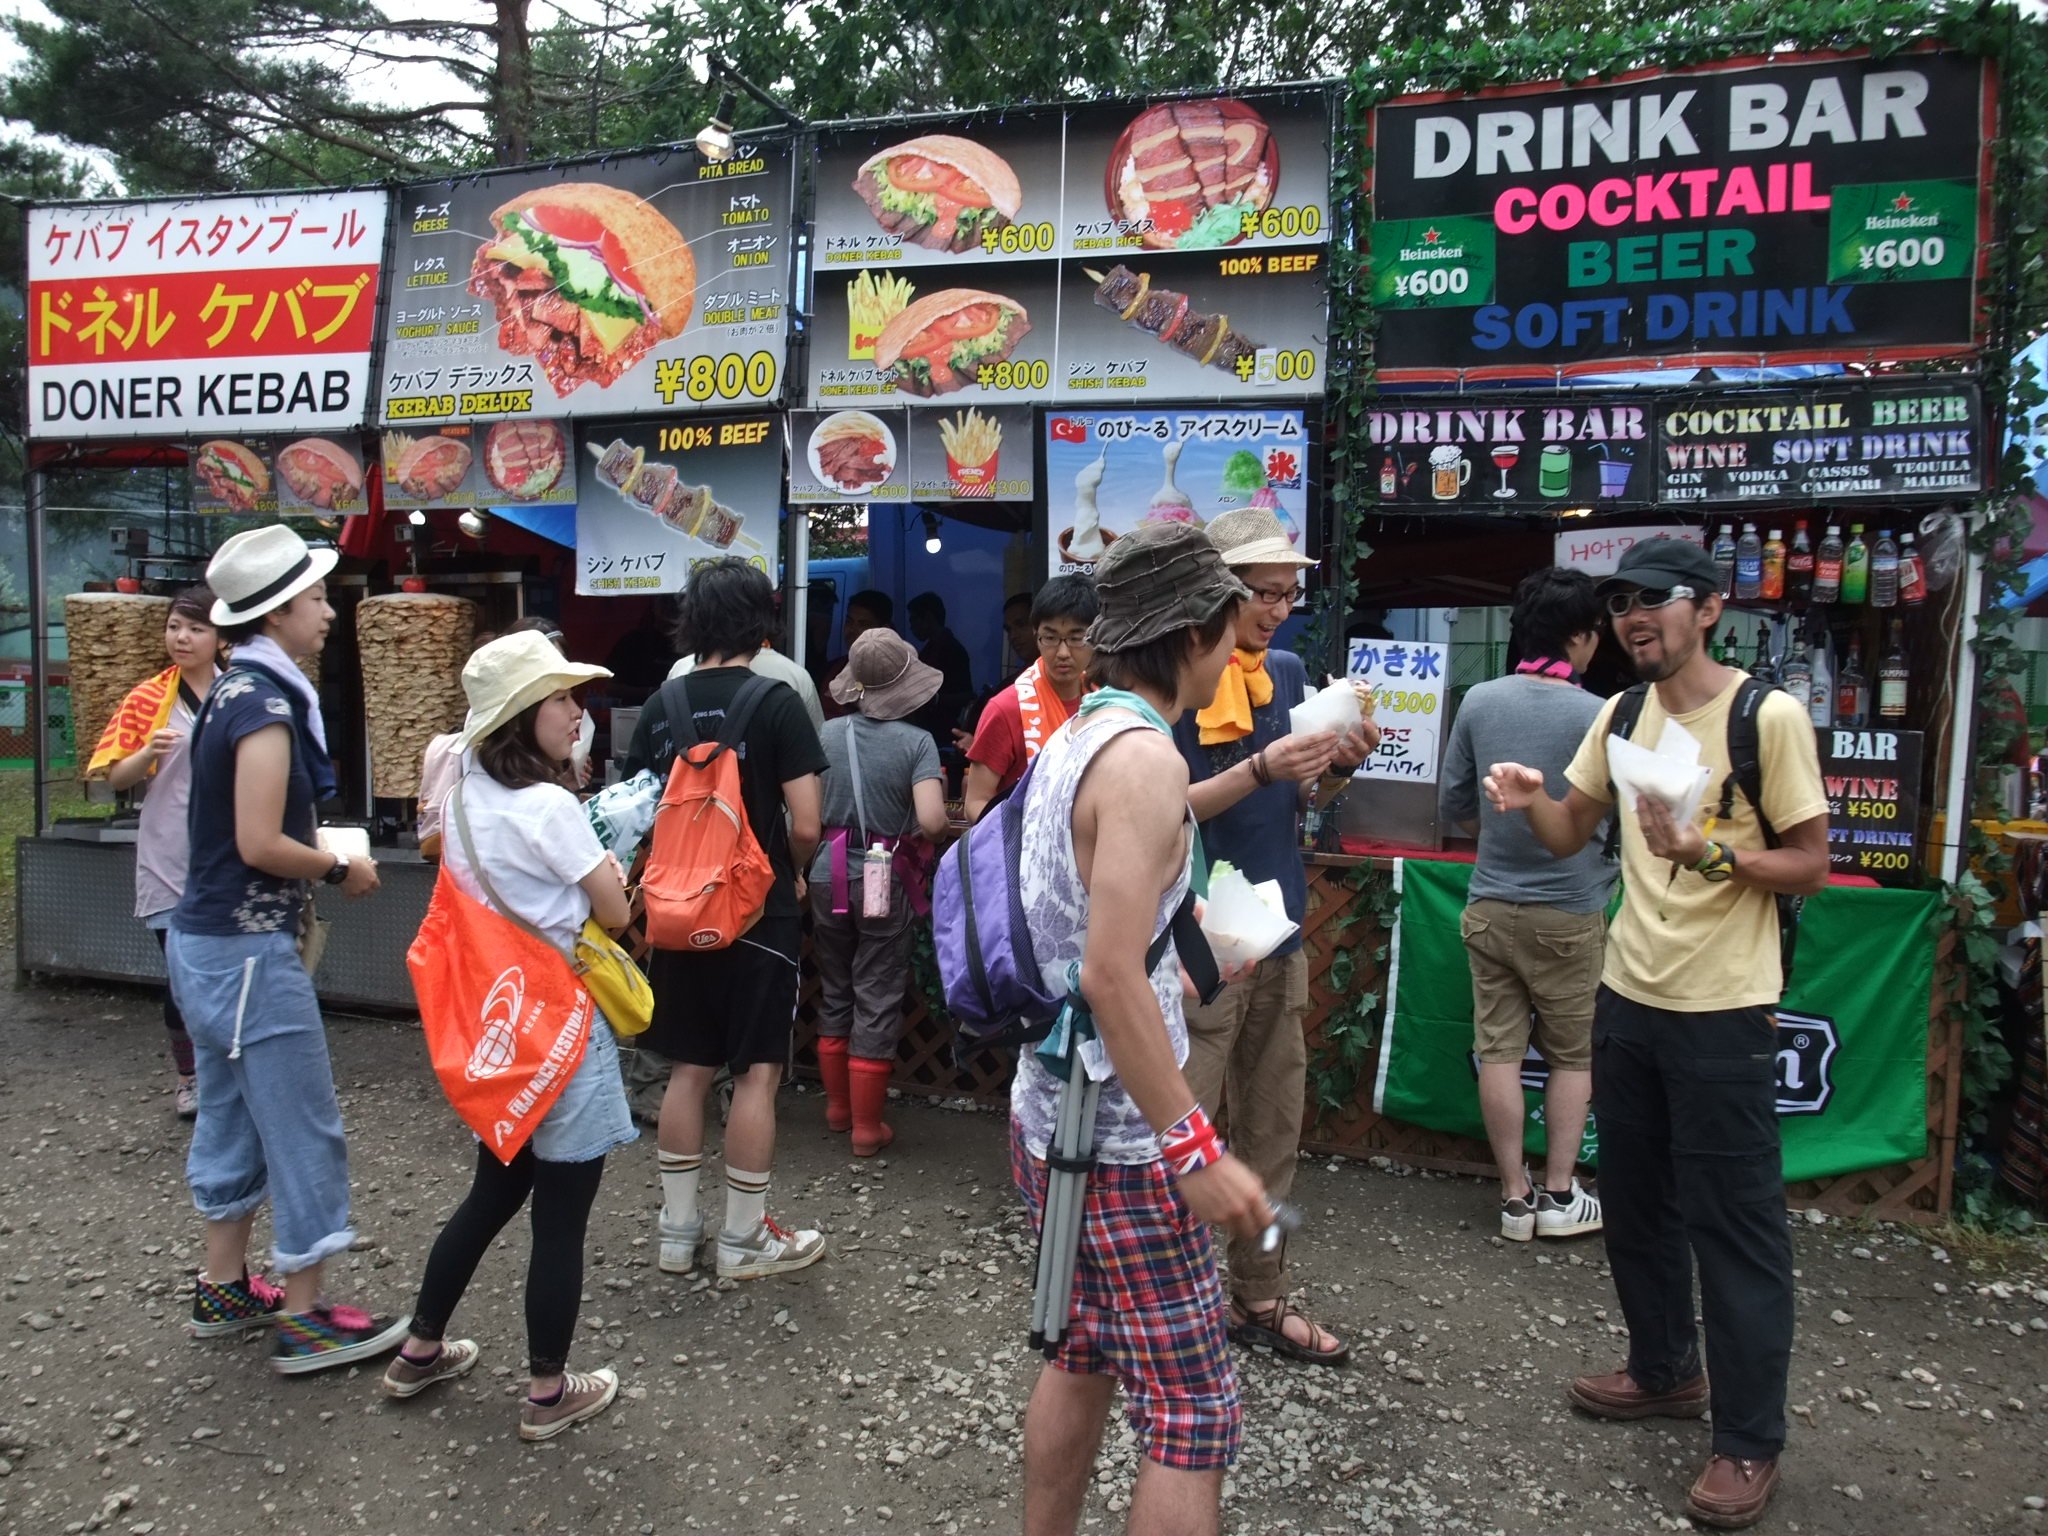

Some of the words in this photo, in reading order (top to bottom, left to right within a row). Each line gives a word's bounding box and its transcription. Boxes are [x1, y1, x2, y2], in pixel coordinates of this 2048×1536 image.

[1413, 90, 1700, 179] DRINK
[1729, 70, 1929, 153] BAR
[699, 164, 723, 179] PITA
[728, 159, 764, 175] BREAD
[730, 194, 760, 212] トマト
[1494, 163, 1831, 235] COCKTAIL
[415, 201, 451, 219] チーズ
[722, 208, 769, 225] TOMATO
[413, 218, 449, 233] CHEESE
[1074, 221, 1115, 236] ケバブ
[1118, 219, 1156, 233] ライス
[1241, 205, 1321, 240] ¥600
[1865, 214, 1938, 230] Heineken
[45, 218, 134, 265] ケバブ
[147, 208, 366, 259] イスタンブール
[727, 235, 778, 253] オニオン
[826, 236, 860, 250] ドネル
[866, 234, 904, 248] ケバブ
[981, 223, 1054, 255] ¥600
[1073, 238, 1112, 250] KEBAB
[1116, 236, 1144, 248] RICE
[733, 251, 769, 267] ONION
[825, 251, 864, 264] DONER
[865, 249, 903, 262] KEBAB
[1400, 247, 1463, 261] Heineken
[1568, 229, 1756, 289] BEER
[1859, 237, 1944, 269] ¥600
[414, 257, 445, 272] レタス
[1220, 257, 1262, 276] 100%
[1267, 254, 1319, 273] BEEF
[407, 272, 449, 287] LETTUCE
[1395, 267, 1469, 297] ¥600
[704, 293, 743, 309] ダブル
[748, 288, 781, 305] ミート
[40, 285, 176, 356] ドネル
[199, 272, 370, 349] ケバブ
[396, 307, 445, 323] ヨーグルト
[450, 304, 481, 318] ソース
[703, 309, 745, 325] DOUBLE
[751, 305, 780, 320] MEAT
[1471, 299, 1628, 351] SOFT
[1646, 286, 1855, 341] DRINK
[396, 325, 441, 338] YOGHURT
[446, 321, 479, 335] SAUCE
[820, 369, 845, 382] ドネル
[976, 360, 1049, 391] ¥800
[1069, 362, 1096, 376] シシ
[1105, 359, 1149, 375] ケバブ
[1235, 350, 1315, 383] ¥500
[389, 368, 442, 393] ケバブ
[448, 363, 533, 389] デラックス
[655, 350, 776, 405] ¥800
[1068, 378, 1103, 389] SHISH
[1107, 376, 1147, 387] KEBAB
[43, 376, 182, 421] DONER
[198, 370, 350, 417] KEBAB
[819, 385, 848, 397] DONER
[849, 384, 878, 396] KEBAB
[880, 383, 898, 395] SET
[386, 395, 455, 420] KEBAB
[459, 389, 533, 415] DELUX
[1069, 417, 1093, 427] トルコ
[1180, 418, 1298, 437] アイスクリーム
[1368, 409, 1526, 444] DRINK
[1542, 407, 1647, 441] BAR
[1666, 403, 1850, 437] COCKTAIL
[1872, 397, 1969, 426] BEER
[658, 427, 712, 451] 100%
[720, 422, 770, 445] BEEF
[1666, 442, 1747, 469] WINE
[1772, 436, 1852, 465] SOFT
[1861, 430, 1971, 460] DRINK
[1267, 451, 1296, 481] 氷
[1667, 472, 1702, 485] GIN
[1728, 470, 1789, 483] VODKA
[1807, 465, 1870, 479] CASSIS
[1892, 460, 1971, 475] TEQUILA
[539, 488, 574, 501] ¥600
[871, 484, 907, 497] ¥600
[989, 480, 1030, 495] ¥300
[1667, 487, 1707, 499] RUM
[1738, 484, 1780, 496] DITA
[1801, 479, 1882, 493] CAMPARI
[1903, 474, 1971, 488] MALIBU
[587, 556, 613, 574] シシ
[620, 552, 666, 572] ケバブ
[590, 578, 621, 589] SHISH
[623, 576, 661, 588] KEBAB
[1351, 643, 1441, 680] かき氷
[1381, 690, 1437, 714] ¥300
[1831, 731, 1898, 760] BAR
[1824, 776, 1898, 800] WINE
[1848, 801, 1897, 819] ¥500
[1853, 829, 1912, 847] DRINK
[1860, 851, 1909, 869] ¥200
[521, 1000, 545, 1034] BEAMS
[507, 1087, 538, 1119] FUJI
[528, 1059, 560, 1093] ROCK
[549, 1005, 585, 1062] FESTIVAL
